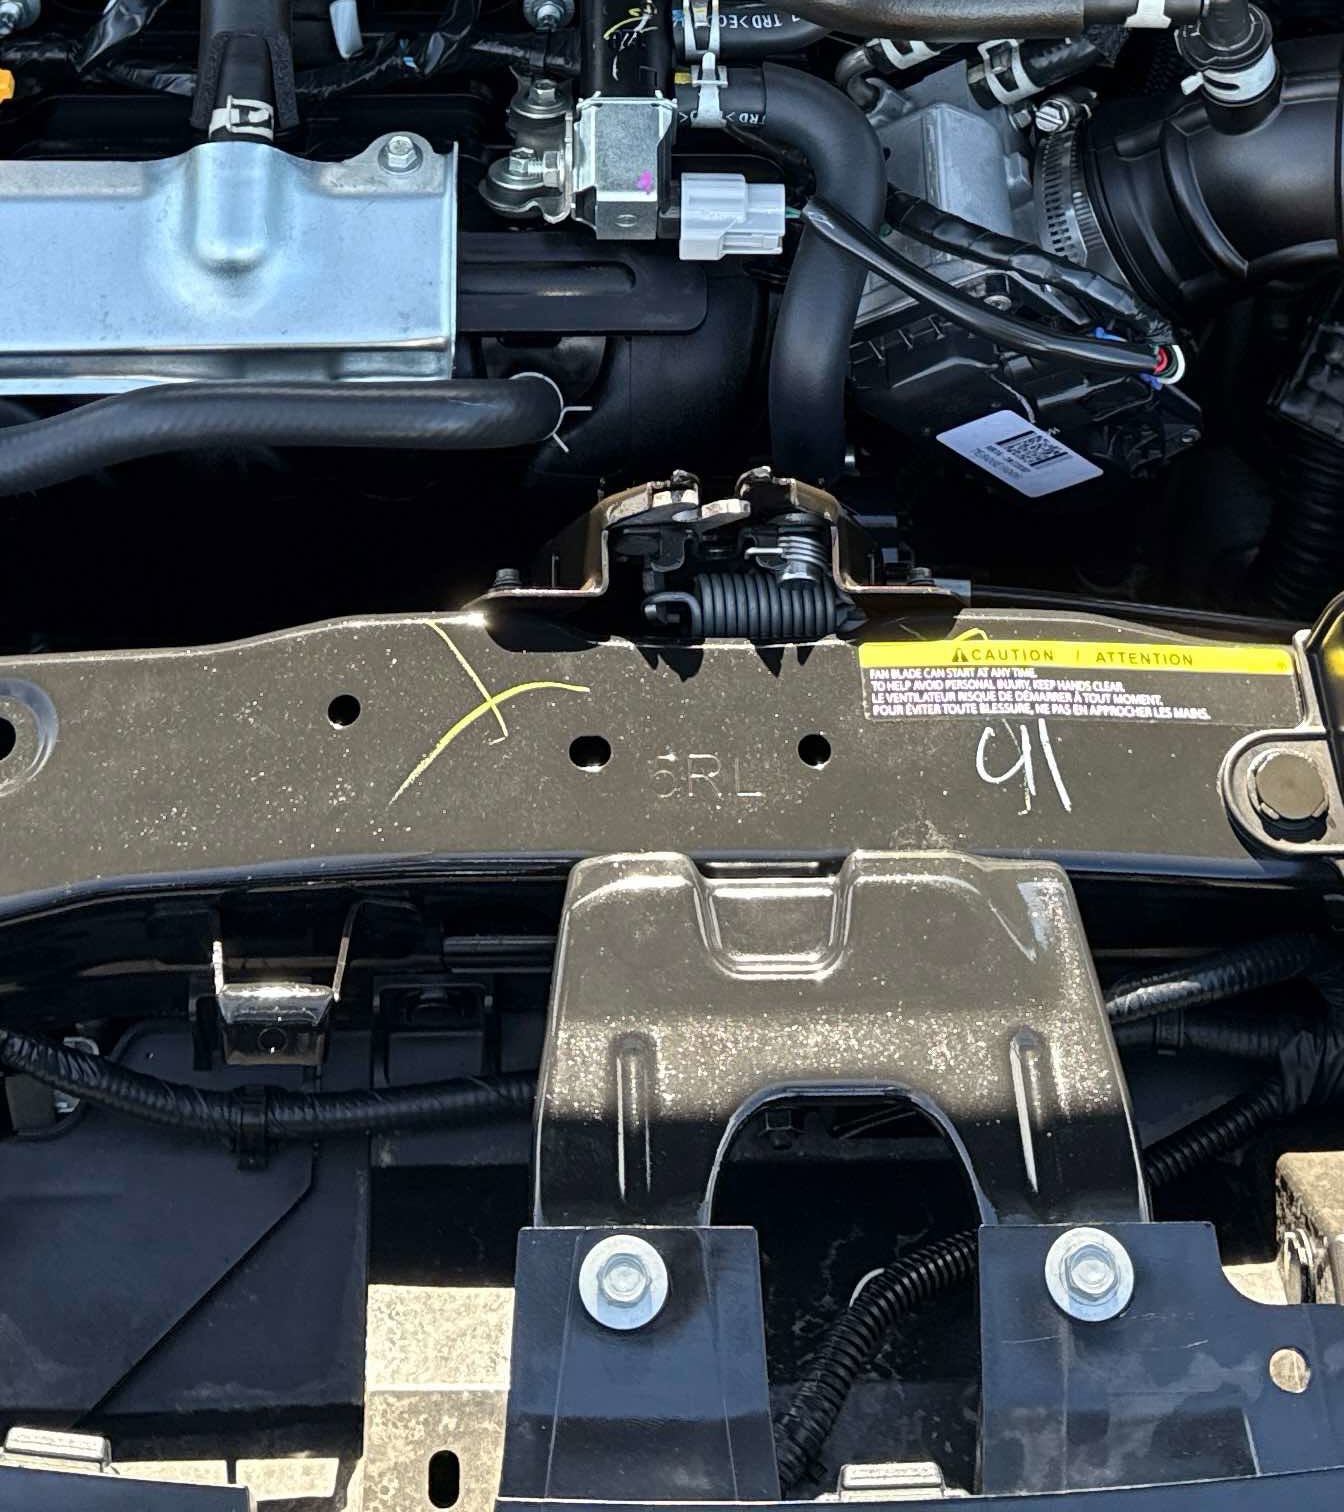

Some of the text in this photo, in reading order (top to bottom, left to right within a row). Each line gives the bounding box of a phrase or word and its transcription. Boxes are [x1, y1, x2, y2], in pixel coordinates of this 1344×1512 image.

[971, 648, 1054, 661] CAUTION
[1096, 651, 1194, 666] ATTENTION
[869, 667, 1038, 680] FAN BLADE CAN START AT ANY TIME.
[871, 679, 1126, 693] TO HELP AVOID PERSONAL INJURY, KEEP HANDS CLEAR.
[872, 692, 885, 704] LE
[886, 691, 956, 703] VENTILATEUR
[957, 691, 998, 704] RISQUE
[998, 691, 1013, 702] DE
[1014, 690, 1072, 704] DÉMARRER
[1082, 692, 1113, 704] TOUT
[1113, 693, 1164, 706] MOMENT.
[873, 701, 1212, 720] POUR ÉVITER TOUTE BLESSURE, NE PAS EN APPROCHER LES MAINS.
